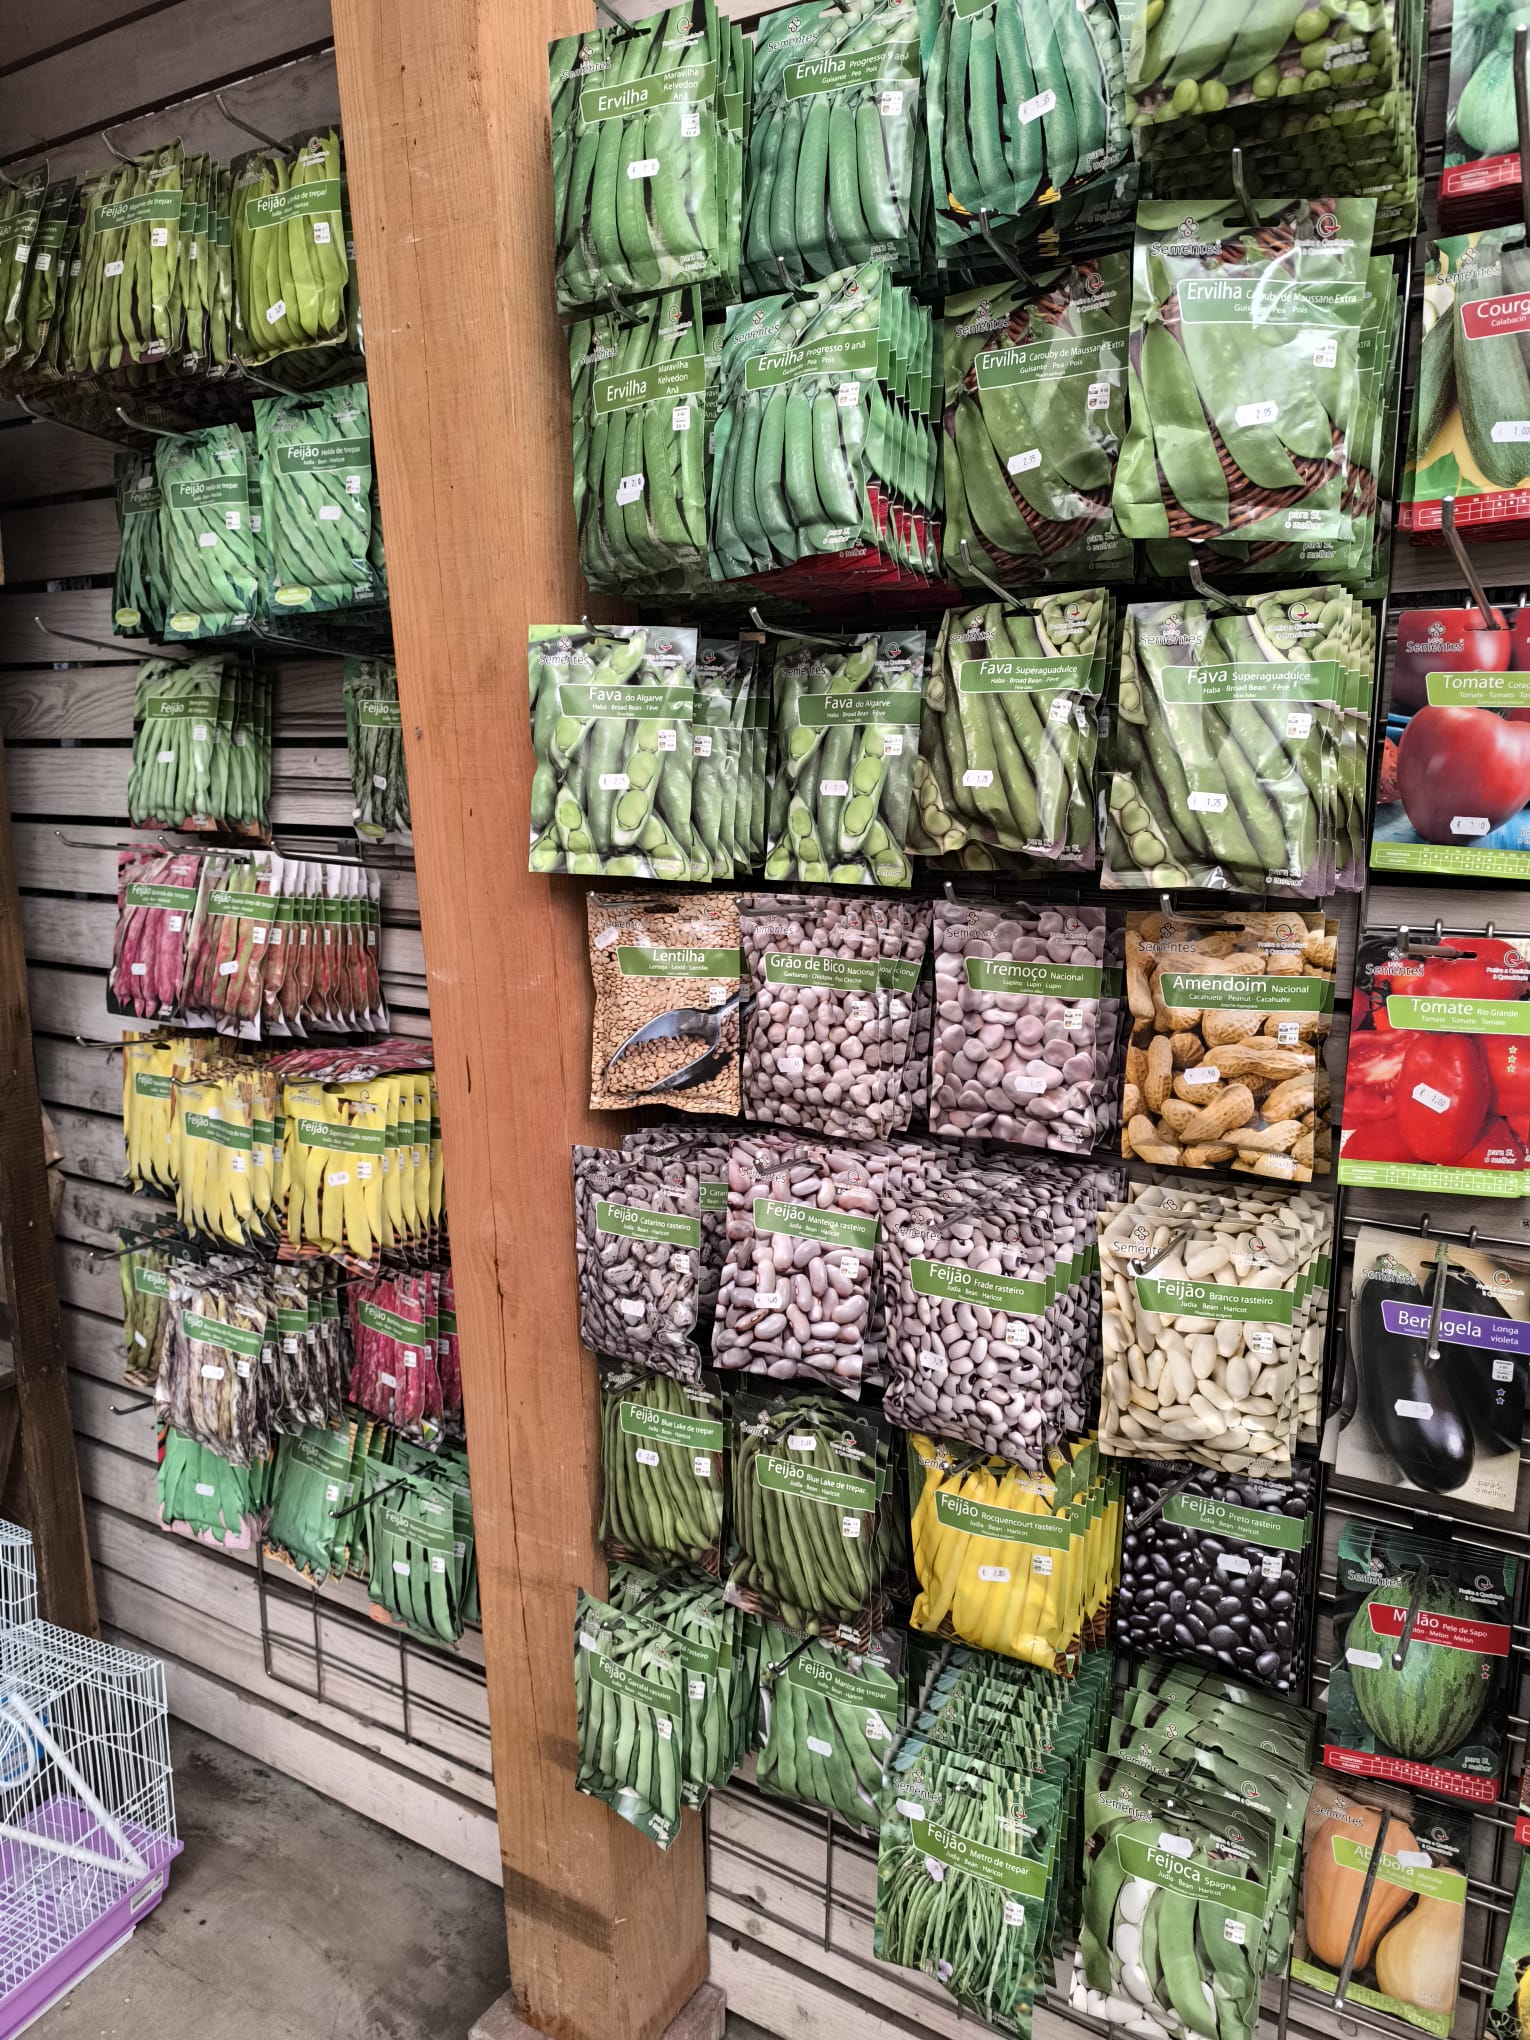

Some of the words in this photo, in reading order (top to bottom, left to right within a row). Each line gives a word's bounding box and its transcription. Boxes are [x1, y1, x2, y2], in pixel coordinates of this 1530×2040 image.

[767, 32, 818, 52] Sementes
[796, 58, 846, 79] Ervilha
[849, 54, 885, 68] Progresso
[664, 68, 699, 81] Maravilha
[822, 74, 846, 84] Guisante
[664, 80, 698, 89] Kelvedon
[598, 89, 648, 111] Ervilha
[101, 204, 128, 218] Feijão
[257, 196, 286, 211] Feijão
[1151, 242, 1222, 257] Sementes
[1187, 282, 1242, 301] Ervilha
[1334, 293, 1357, 304] Extra
[758, 351, 804, 371] Ervilha
[806, 344, 842, 357] Progresso
[844, 343, 850, 351] 9
[852, 341, 866, 351] anã
[982, 352, 1027, 369] Ervilha
[1030, 350, 1058, 361] Carouby
[1060, 349, 1069, 357] de
[1071, 343, 1105, 356] Maussane
[1107, 340, 1125, 349] Extra
[658, 361, 688, 372] Maravilha
[1020, 364, 1047, 374] Guisante
[1069, 359, 1083, 367] Pois
[658, 373, 688, 383] Kelvedon
[607, 382, 647, 401] Ervilha
[667, 385, 679, 394] Anã
[288, 447, 318, 459] Feijão
[180, 484, 204, 495] Feijão
[1139, 632, 1202, 647] Sementes
[980, 660, 1012, 676] Fava
[1016, 665, 1077, 676] Superaguadulce
[1187, 669, 1228, 684] Fava
[1232, 671, 1310, 683] Superaguadulce
[1443, 675, 1504, 688] Tomate
[589, 688, 622, 701] Fava
[626, 694, 635, 702] do
[637, 694, 663, 703] Algarve
[825, 696, 852, 709] Fava
[865, 699, 891, 708] Algarve
[161, 702, 184, 713] Feijão
[363, 701, 388, 714] Feijão
[132, 885, 151, 895] Feijão
[211, 892, 230, 903] Feijão
[1138, 941, 1195, 953] Sementes
[653, 949, 705, 963] Lentilha
[770, 956, 802, 969] Grão
[806, 958, 819, 971] de
[823, 959, 845, 973] Bico
[847, 967, 875, 977] Nacional
[984, 961, 1048, 981] Tremoço
[1050, 972, 1083, 981] Nacional
[1366, 964, 1424, 976] Sementes
[1045, 982, 1061, 990] Lupin
[1173, 976, 1267, 992] Amendoim
[1272, 985, 1309, 993] Nacional
[1411, 998, 1473, 1015] Tomate
[187, 1114, 208, 1127] Feijão
[301, 1120, 328, 1135] Feijão
[608, 1204, 638, 1222] Feijão
[640, 1216, 665, 1228] Catarino
[667, 1220, 691, 1231] rasteiro
[766, 1202, 805, 1221] Feijão
[808, 1215, 838, 1229] Manteiga
[840, 1221, 865, 1232] rasteiro
[143, 1271, 166, 1285] Feijão
[930, 1264, 971, 1285] Feijão
[974, 1278, 993, 1290] Frade
[995, 1283, 1025, 1295] rasteiro
[965, 1288, 978, 1296] Bean
[982, 1291, 1002, 1301] Haricot
[1157, 1280, 1204, 1299] Feijão
[1209, 1292, 1239, 1302] Branco
[1241, 1295, 1273, 1305] rasteiro
[364, 1304, 385, 1319] Feijão
[1224, 1305, 1247, 1313] Haricot
[184, 1313, 203, 1328] Feijão
[1493, 1324, 1518, 1334] Longa
[1490, 1334, 1518, 1345] violeta
[630, 1407, 659, 1424] Feijão
[662, 1420, 674, 1428] Blue
[676, 1422, 687, 1430] Lake
[688, 1424, 694, 1432] de
[696, 1426, 714, 1436] trepar
[768, 1459, 804, 1478] Feijão
[807, 1473, 819, 1482] Blue
[821, 1477, 834, 1486] Lake
[845, 1482, 866, 1494] trepar
[385, 1511, 409, 1527] Feijão
[941, 1495, 978, 1517] Feijão
[982, 1513, 1033, 1528] Rocquencourt
[1035, 1522, 1063, 1533] rasteiro
[1181, 1496, 1225, 1517] Feijão
[1229, 1513, 1249, 1524] Preto
[1252, 1518, 1281, 1530] rasteiro
[1007, 1528, 1028, 1536] Haricot
[1219, 1520, 1233, 1529] Bean
[1238, 1526, 1259, 1535] Haricot
[1454, 1635, 1474, 1643] Melon
[1470, 1629, 1488, 1638] Sapo
[599, 1657, 626, 1681] Feijão
[649, 1688, 671, 1701] rasteiro
[798, 1658, 832, 1681] Feijão
[867, 1689, 887, 1699] trepar
[893, 1777, 942, 1804] Sementes
[1098, 1792, 1152, 1822] Sementes
[1314, 1804, 1363, 1827] Sementes
[927, 1823, 966, 1853] Feijão
[970, 1849, 991, 1864] Metro
[994, 1856, 1003, 1867] de
[1005, 1861, 1029, 1876] trepar
[982, 1865, 1003, 1878] Haricot
[1147, 1849, 1200, 1882] Feijoca
[1204, 1877, 1237, 1892] Spagna
[1178, 1879, 1193, 1889] Bean
[1198, 1887, 1221, 1896] Haricot
